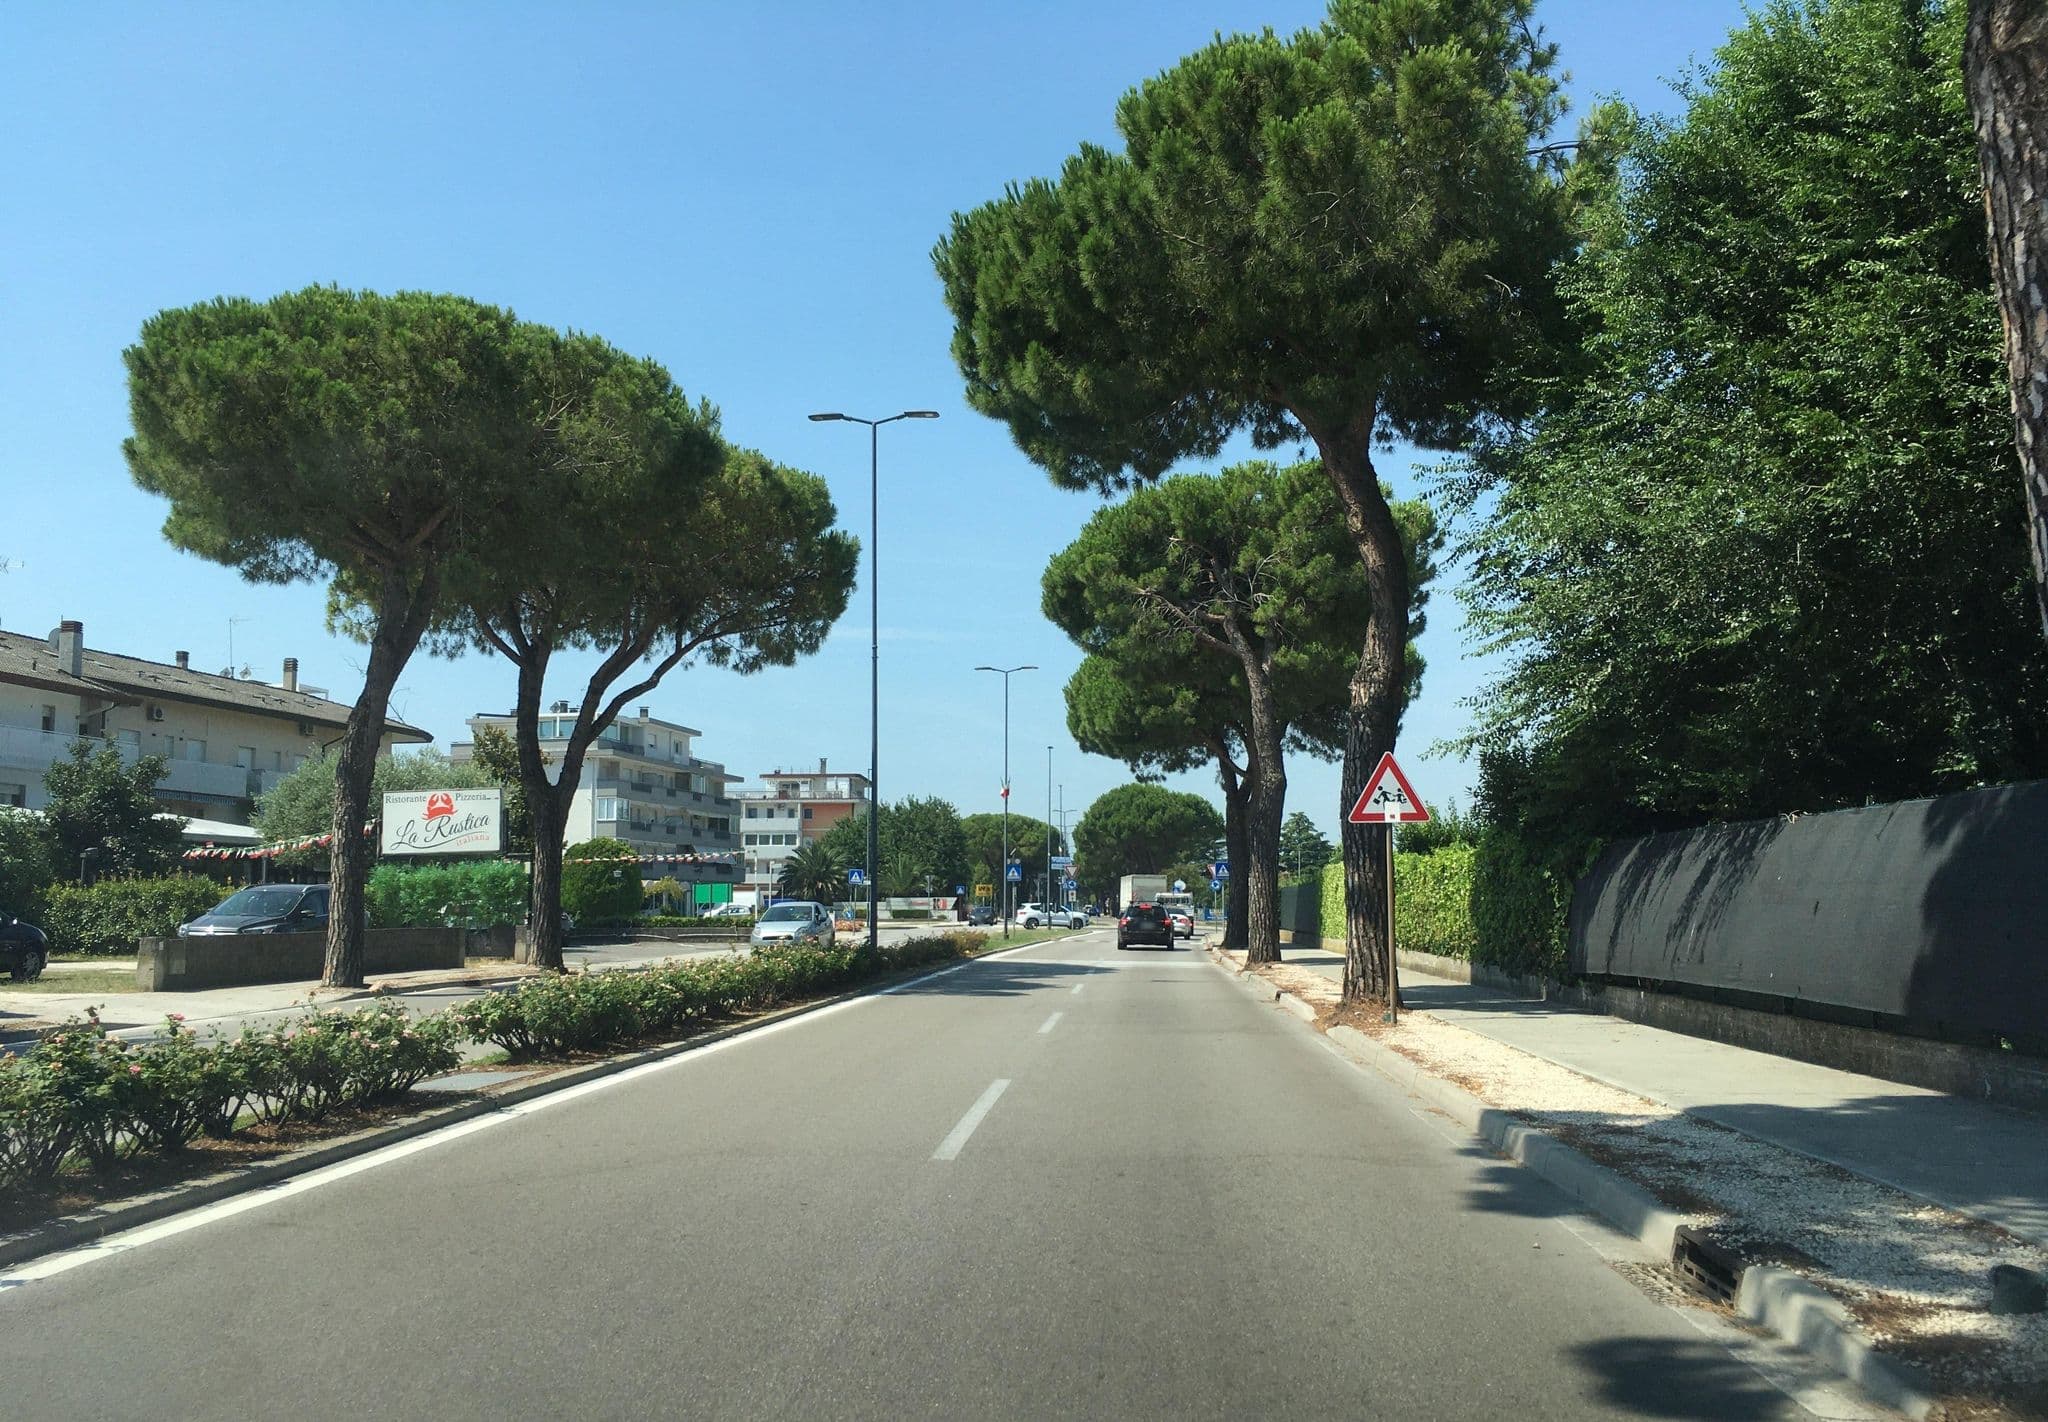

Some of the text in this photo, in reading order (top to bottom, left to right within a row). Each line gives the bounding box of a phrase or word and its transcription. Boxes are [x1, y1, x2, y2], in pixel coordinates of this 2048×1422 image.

[385, 793, 487, 804] Ristorante Pizzeria
[391, 813, 489, 849] La Rustica
